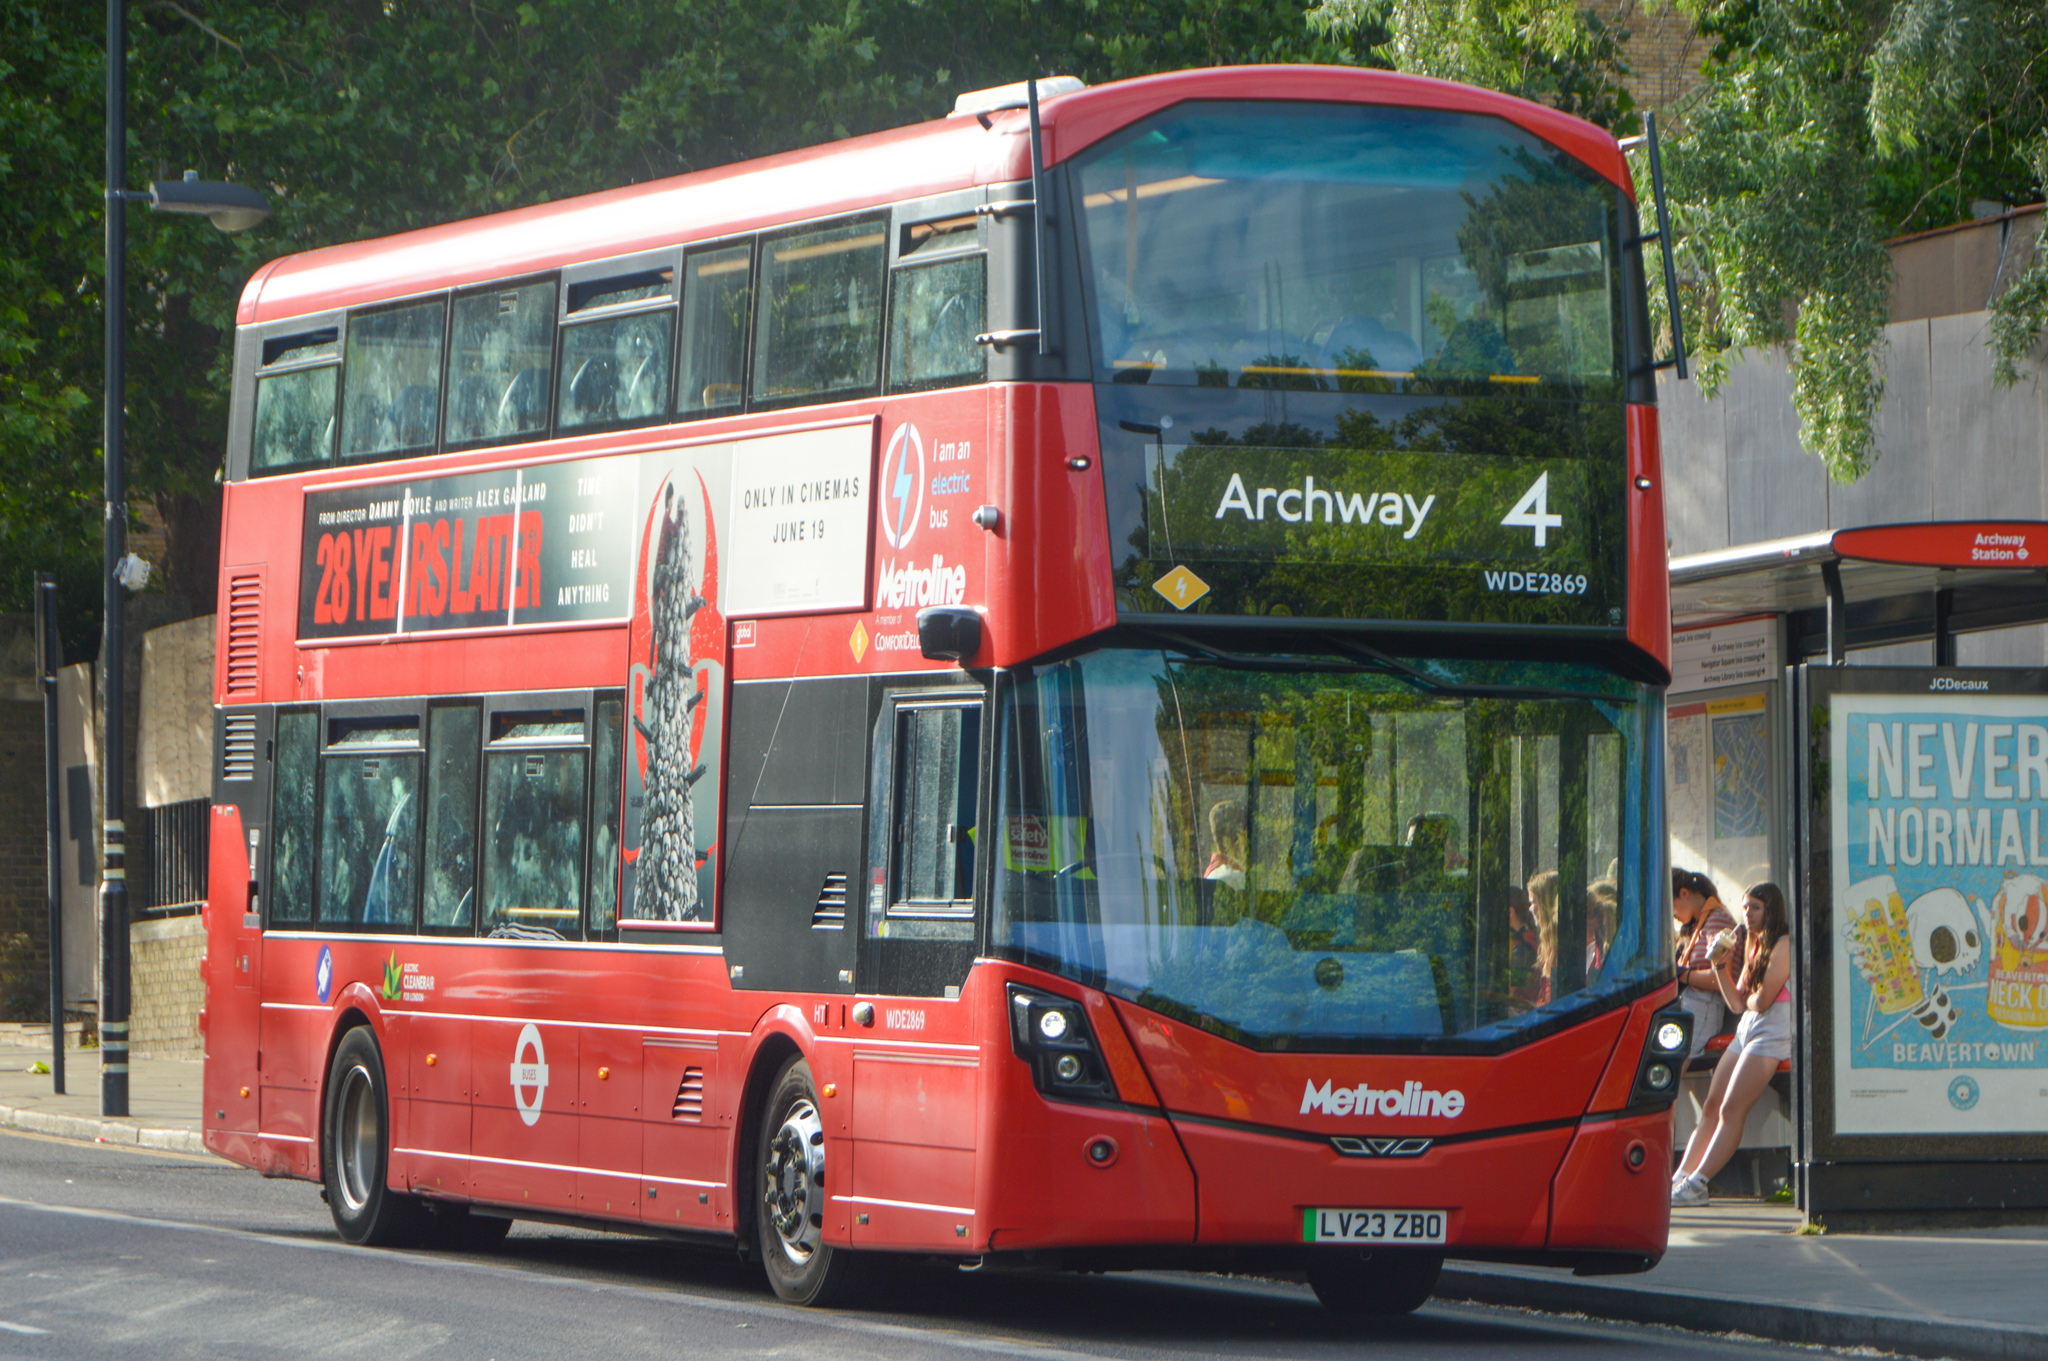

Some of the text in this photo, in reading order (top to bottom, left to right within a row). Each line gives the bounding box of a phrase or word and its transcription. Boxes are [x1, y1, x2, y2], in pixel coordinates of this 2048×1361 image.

[933, 439, 971, 462] I am an
[578, 476, 602, 496] TIME
[744, 477, 860, 508] ONLY IN CINEMAS
[931, 469, 970, 495] electric
[318, 512, 335, 525] FROM
[336, 508, 367, 523] DIRECTOR
[369, 499, 399, 521] DANNY
[434, 498, 448, 512] AND
[449, 496, 473, 511] WRITER
[475, 488, 500, 507] ALEX
[503, 482, 547, 505] GALAND
[1215, 470, 1563, 548] Archway 4
[569, 511, 604, 533] DIDN'T
[929, 506, 948, 528] bus
[773, 519, 825, 543] JUNE 19
[1975, 533, 2026, 547] Archway
[571, 548, 597, 568] HEAL
[1972, 548, 2014, 560] Station
[876, 554, 966, 610] Metroline
[1484, 570, 1588, 595] WDE2869
[558, 583, 609, 606] ANYTHING
[875, 613, 903, 625] A member of
[736, 625, 751, 643] global
[1929, 677, 1989, 690] JCDecaux
[1867, 722, 2048, 801] NEVER
[1011, 827, 1047, 846] safety
[1867, 807, 2048, 868] NORMAL
[1990, 978, 2033, 1010] NECK
[814, 1004, 925, 1030] HT WDE2869
[522, 1068, 536, 1080] BUSES
[1299, 1078, 1465, 1118] Metroline
[1320, 1212, 1441, 1238] LV23 ZBO
